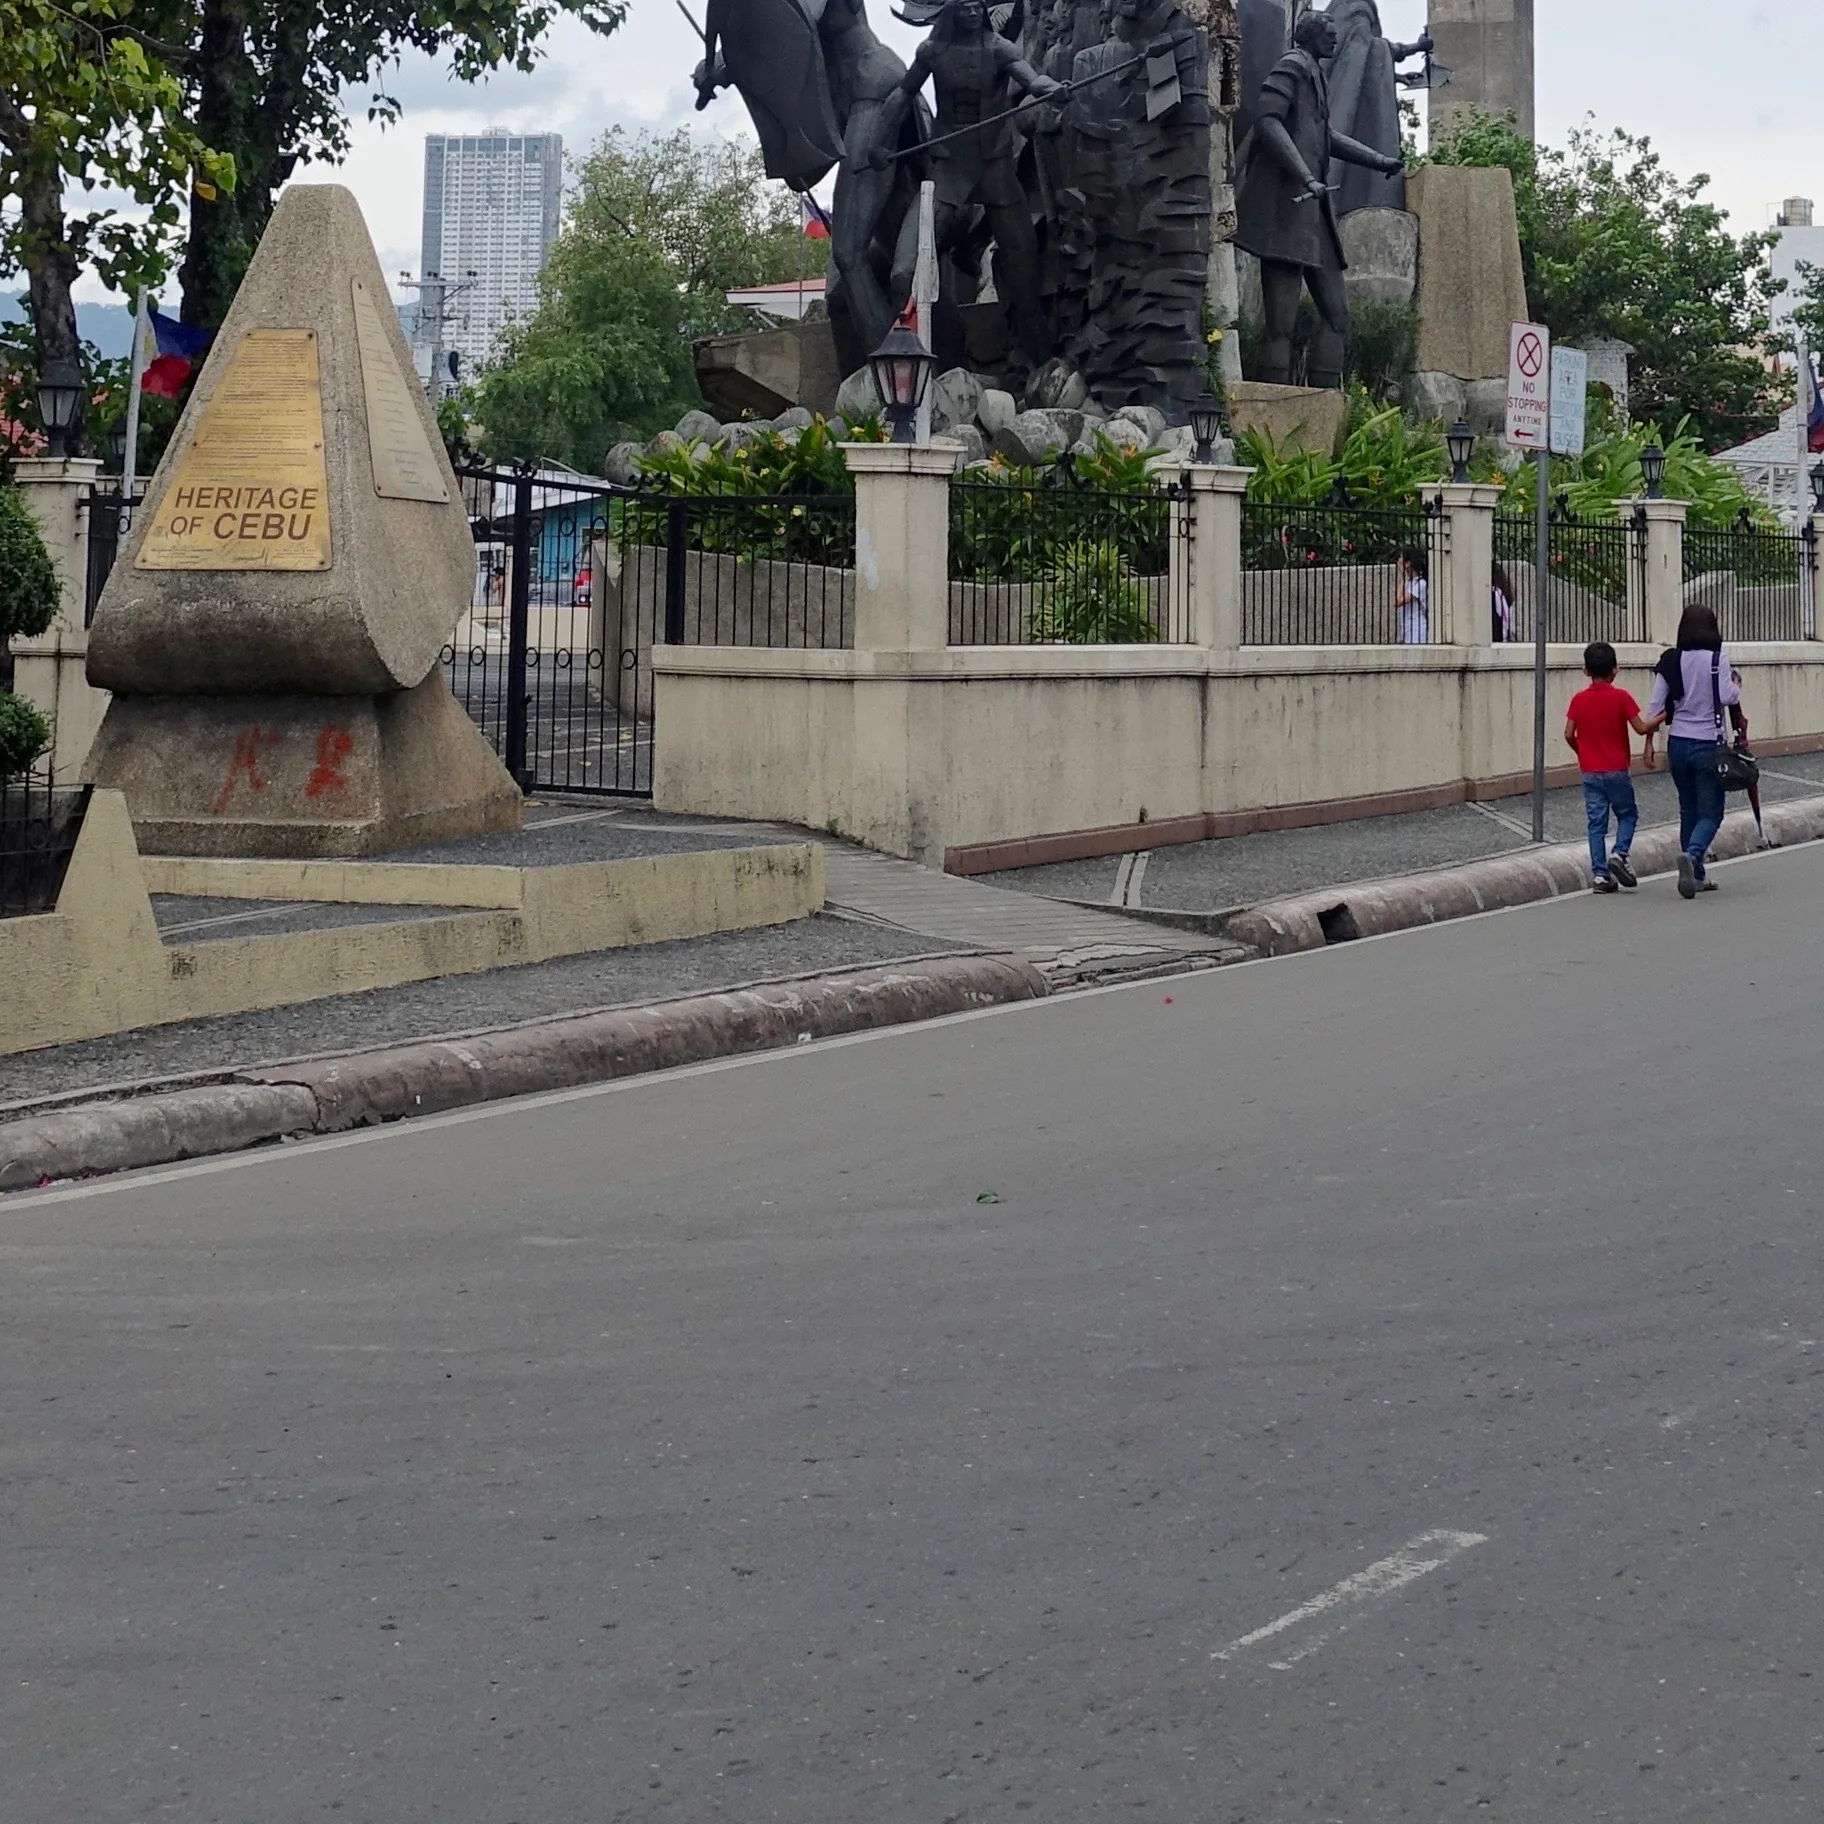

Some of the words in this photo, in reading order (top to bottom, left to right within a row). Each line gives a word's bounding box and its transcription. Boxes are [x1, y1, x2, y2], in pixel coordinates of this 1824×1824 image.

[1559, 370, 1578, 386] AREA
[1522, 380, 1535, 394] NO
[1560, 387, 1576, 400] FOR
[1507, 396, 1547, 412] STOPPING
[1513, 415, 1542, 425] ANYTIME
[1555, 432, 1579, 448] BUSES
[175, 486, 319, 510] HERITAGE
[170, 515, 204, 536] OF
[213, 512, 312, 541] CEBU
